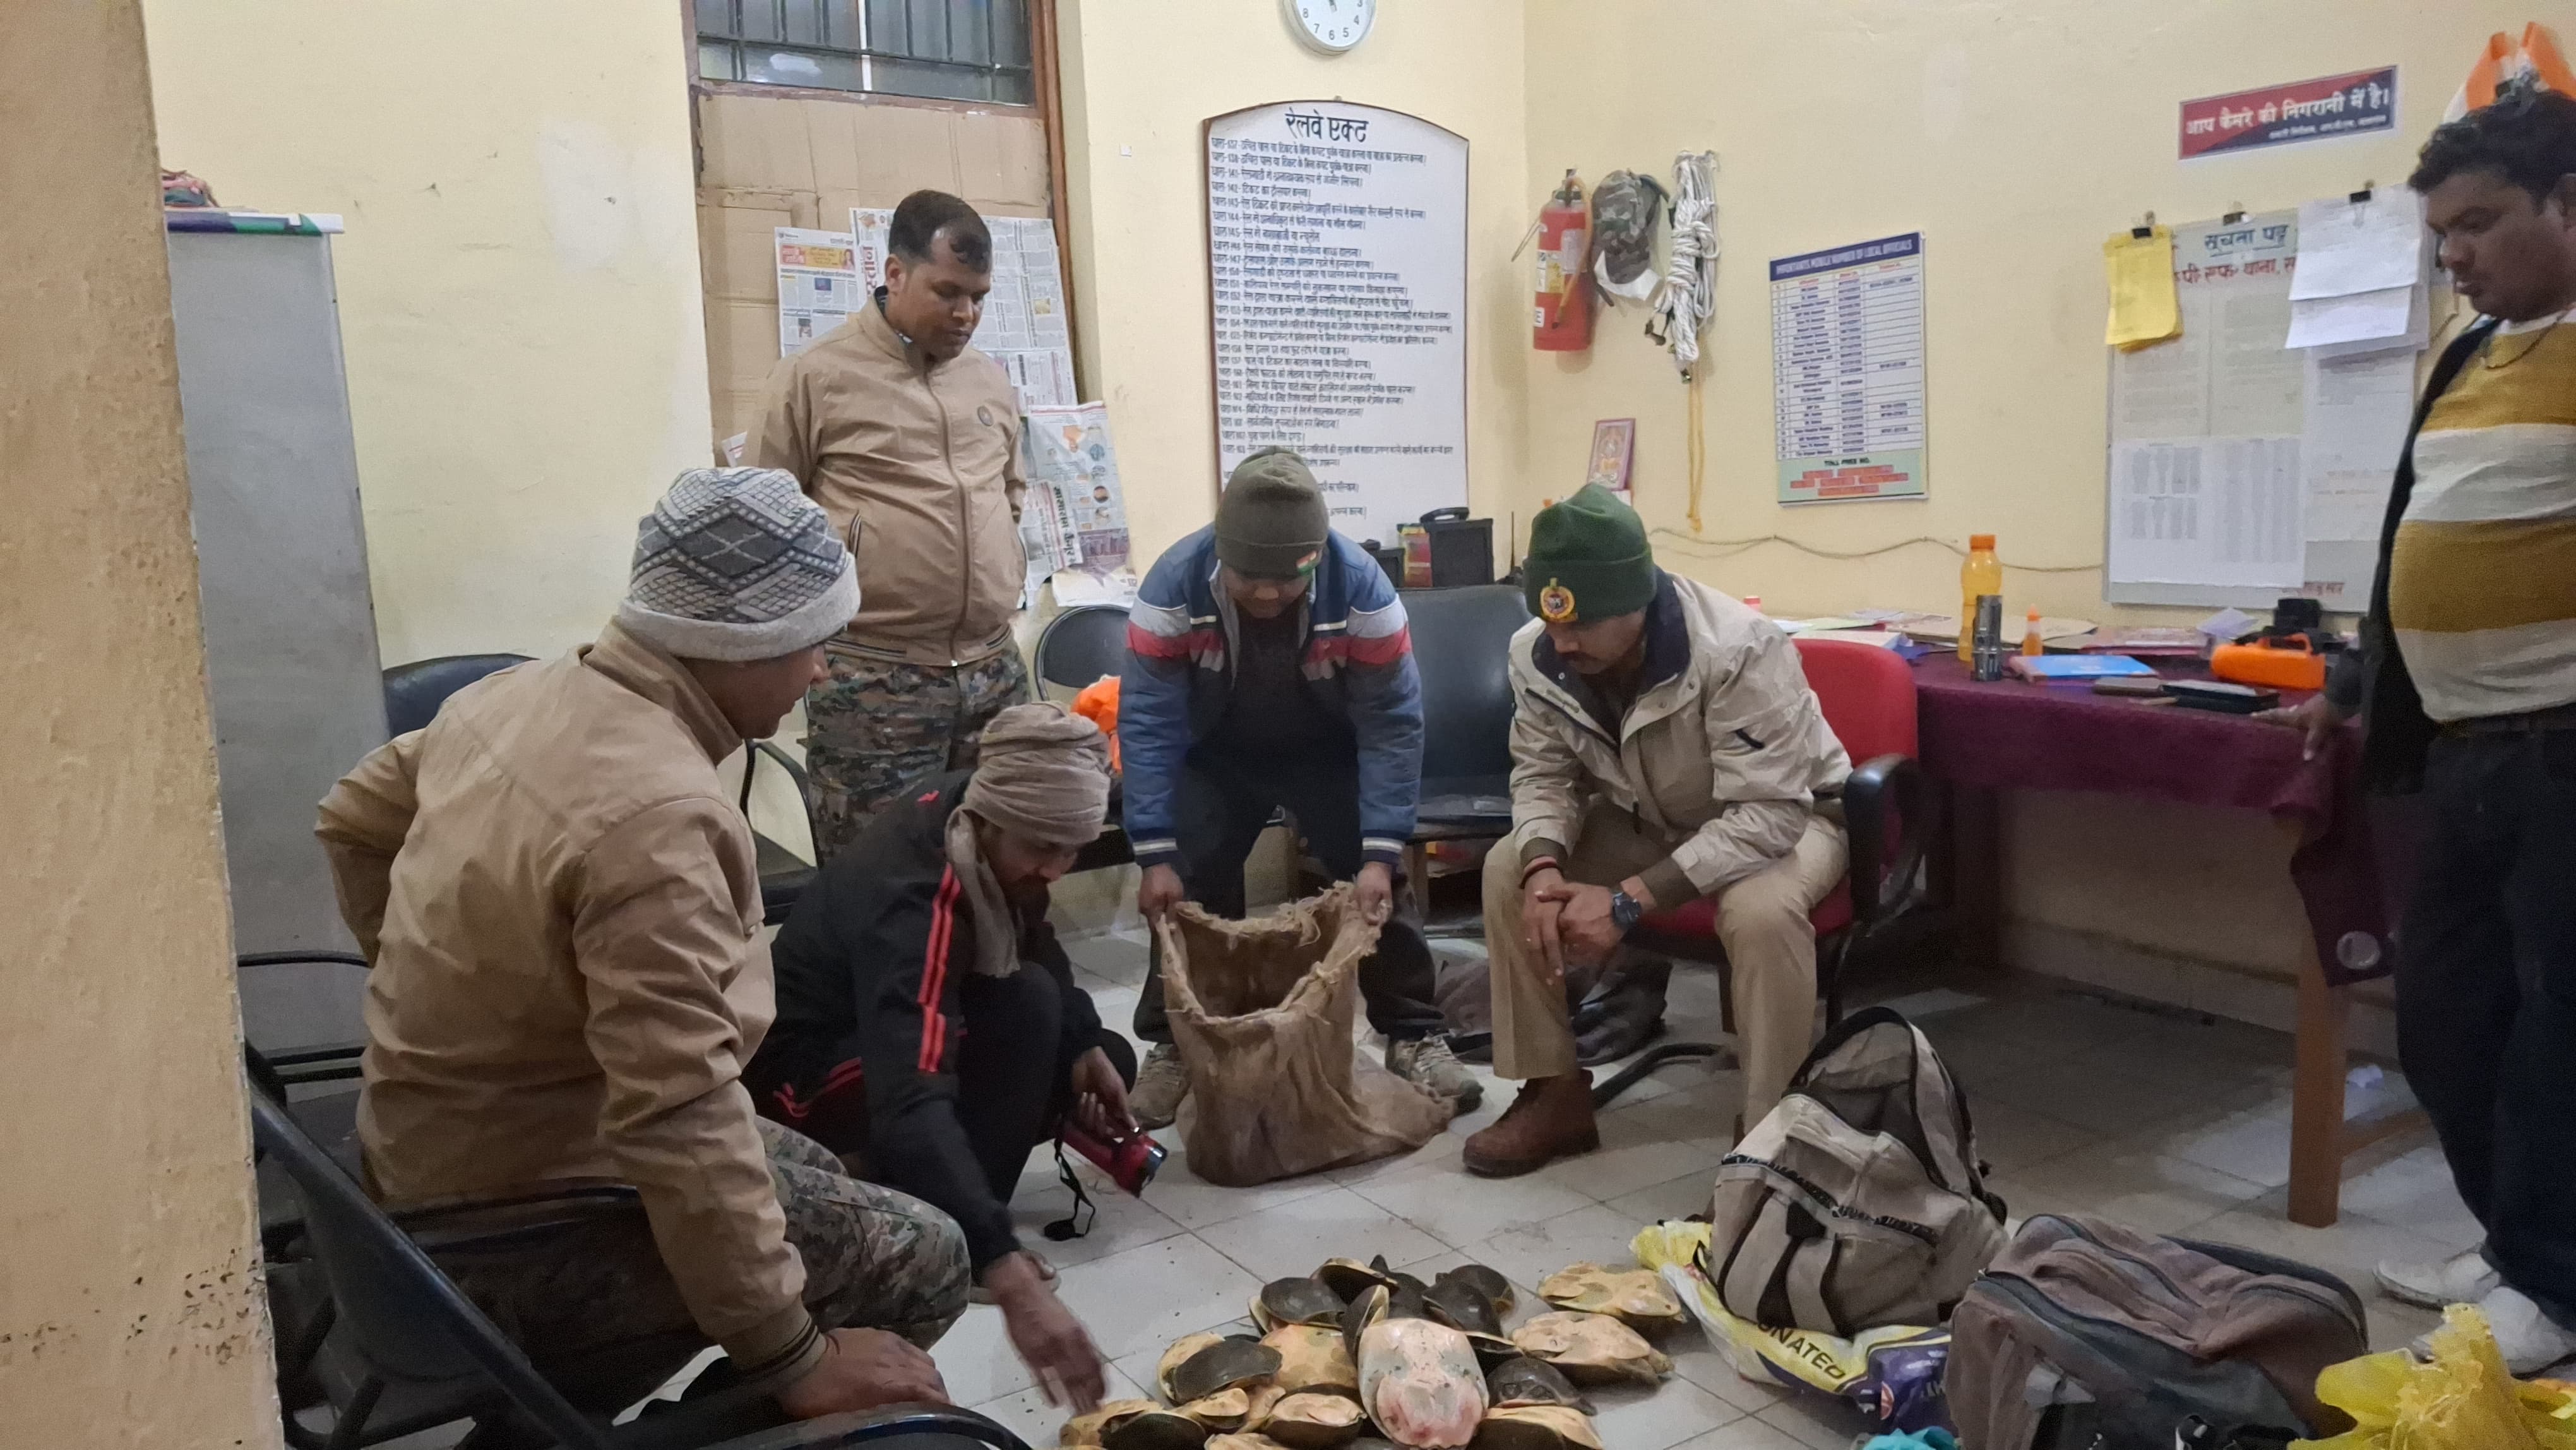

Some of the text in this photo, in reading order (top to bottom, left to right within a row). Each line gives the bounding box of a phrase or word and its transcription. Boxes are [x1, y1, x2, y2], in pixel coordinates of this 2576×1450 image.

[1303, 8, 1308, 18] 8
[1354, 15, 1359, 25] 4
[1314, 23, 1320, 33] 7
[1343, 28, 1349, 37] 5
[1328, 30, 1335, 40] 6
[2186, 117, 2215, 135] आप
[2219, 106, 2254, 129] कैमरे
[2258, 101, 2277, 123] की
[2282, 90, 2344, 121] निगरानी
[1285, 107, 1369, 142] रेलवे एक्ट
[2205, 229, 2255, 252] सूचना
